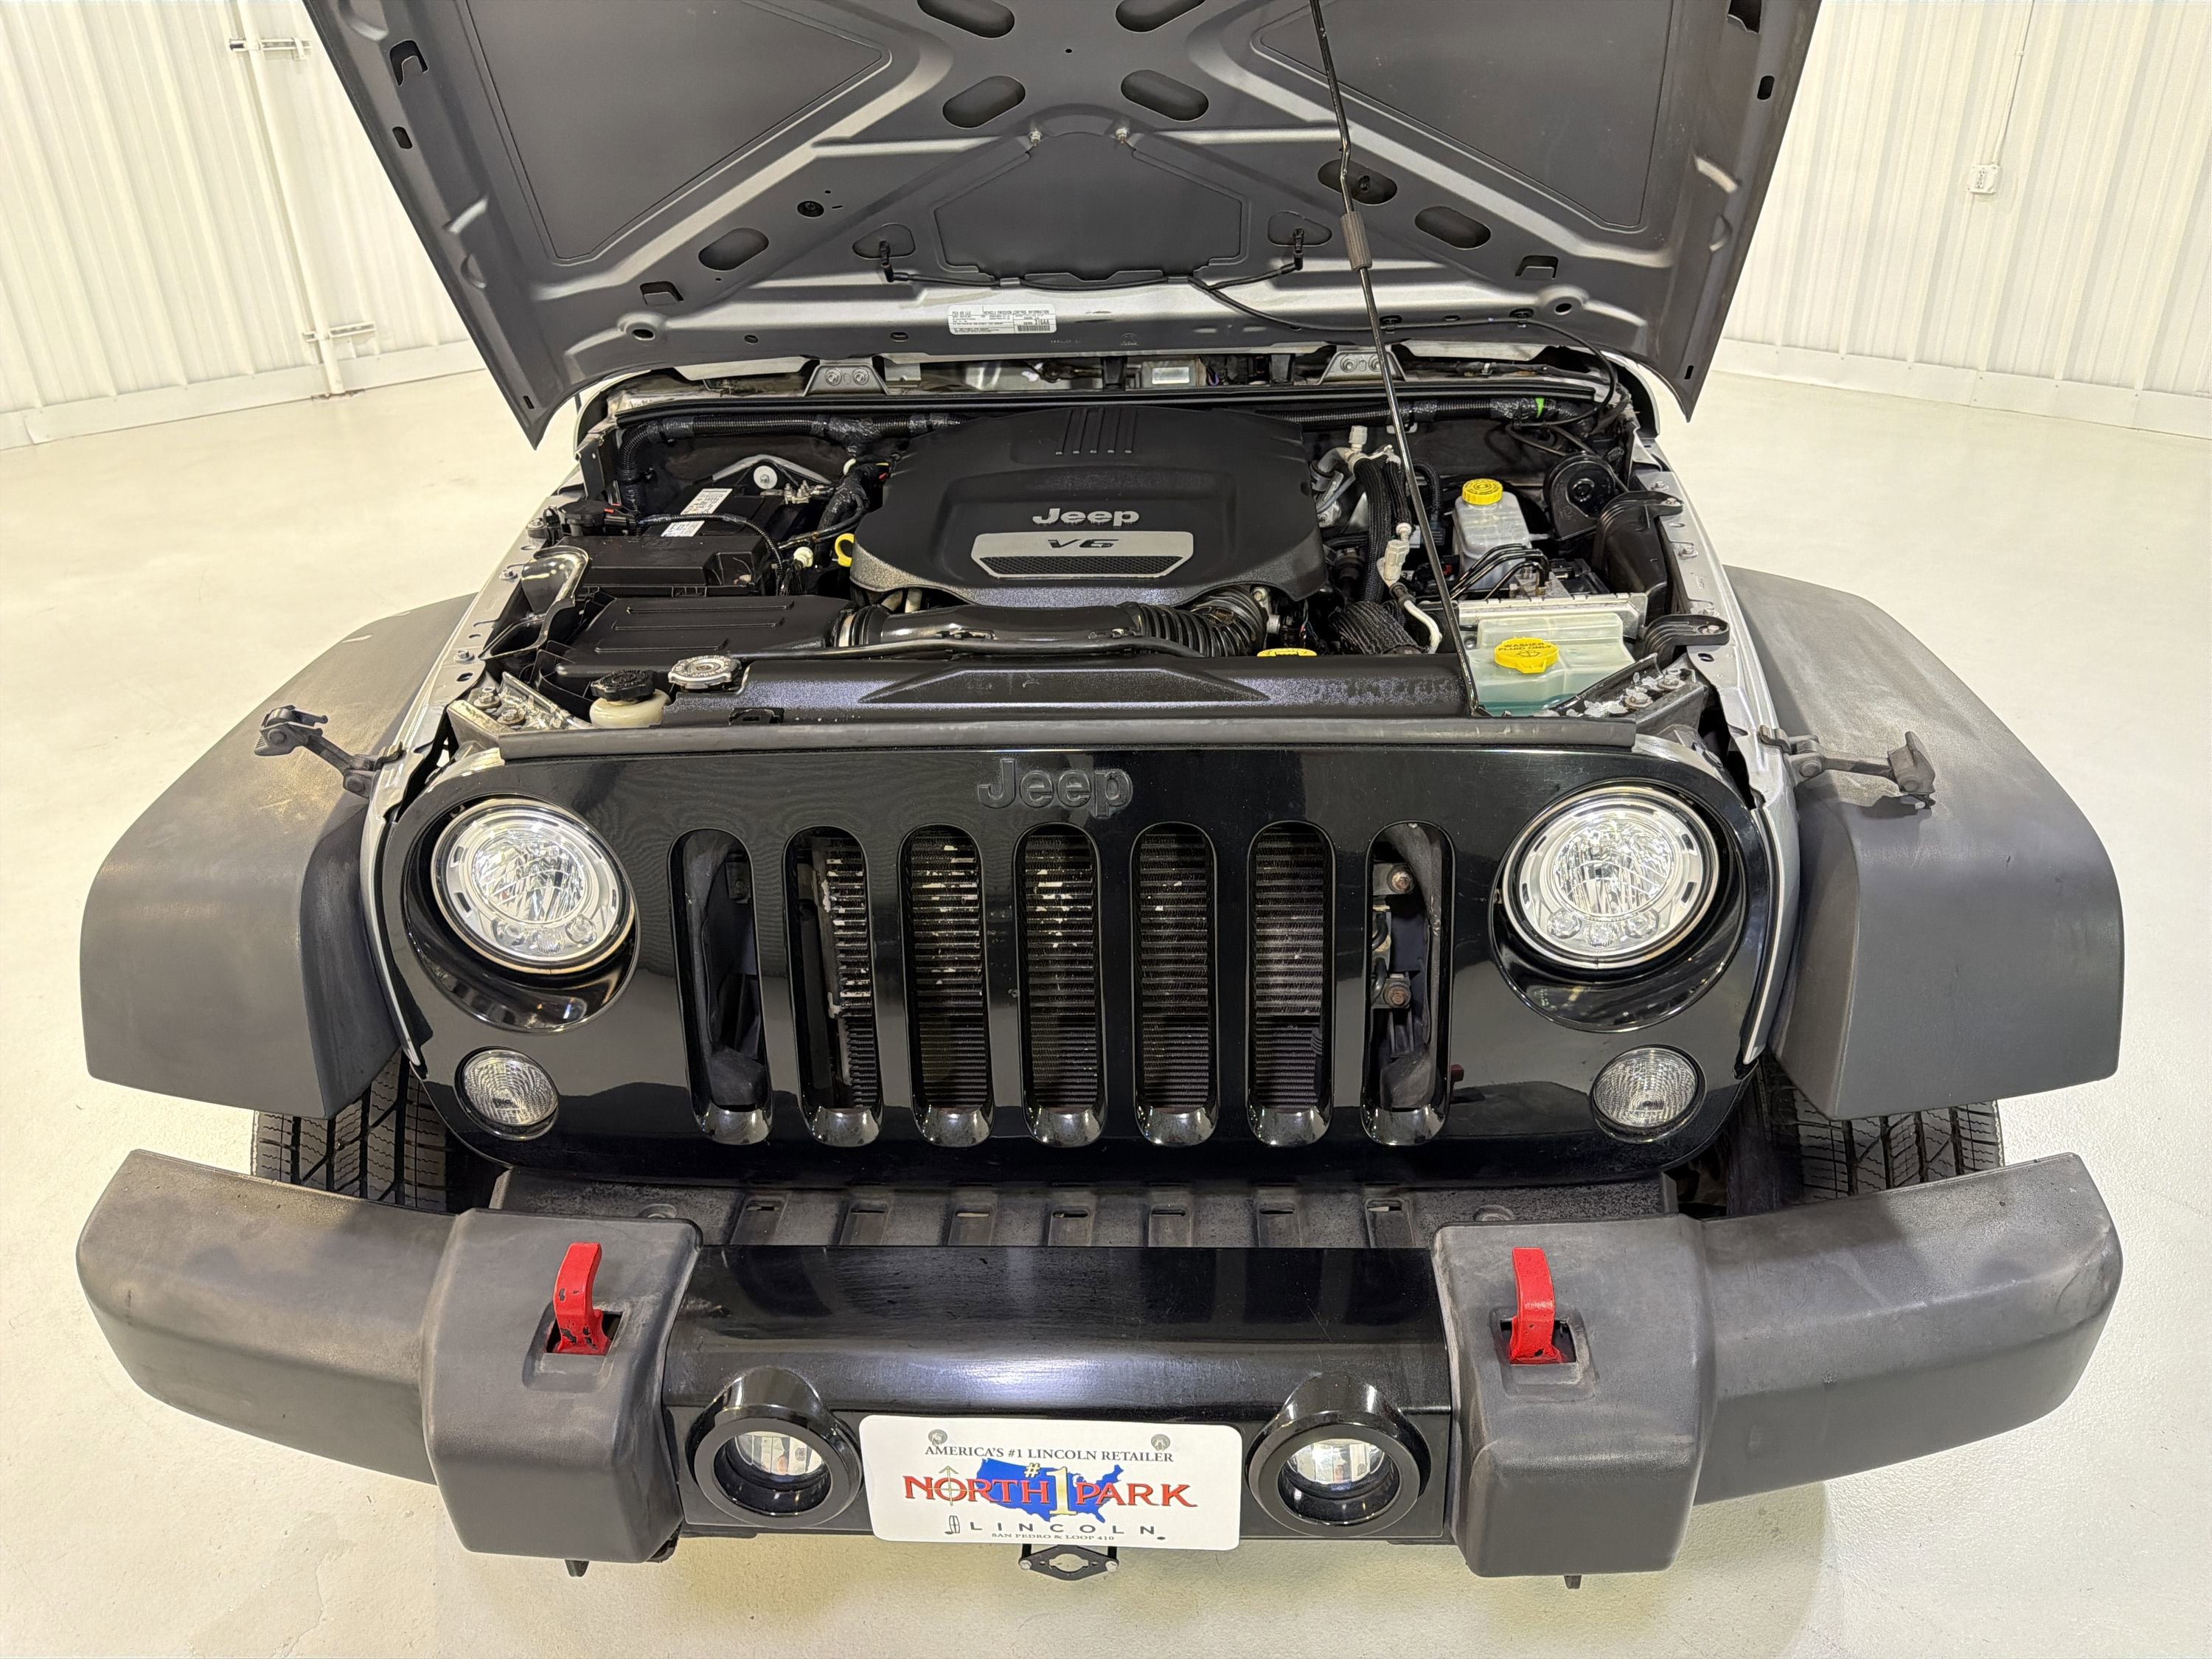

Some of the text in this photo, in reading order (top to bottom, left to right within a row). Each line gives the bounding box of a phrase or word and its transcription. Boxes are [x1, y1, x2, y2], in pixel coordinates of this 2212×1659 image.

[1032, 507, 1140, 528] Jeep
[1048, 538, 1120, 549] V6
[977, 758, 1133, 818] Jeep
[925, 1445, 1175, 1462] AMERICA'S #1 LINCOLN RETAILER
[902, 1475, 1049, 1505] NORTH
[1076, 1481, 1199, 1507] PARK
[970, 1521, 1155, 1535] LINCOLN
